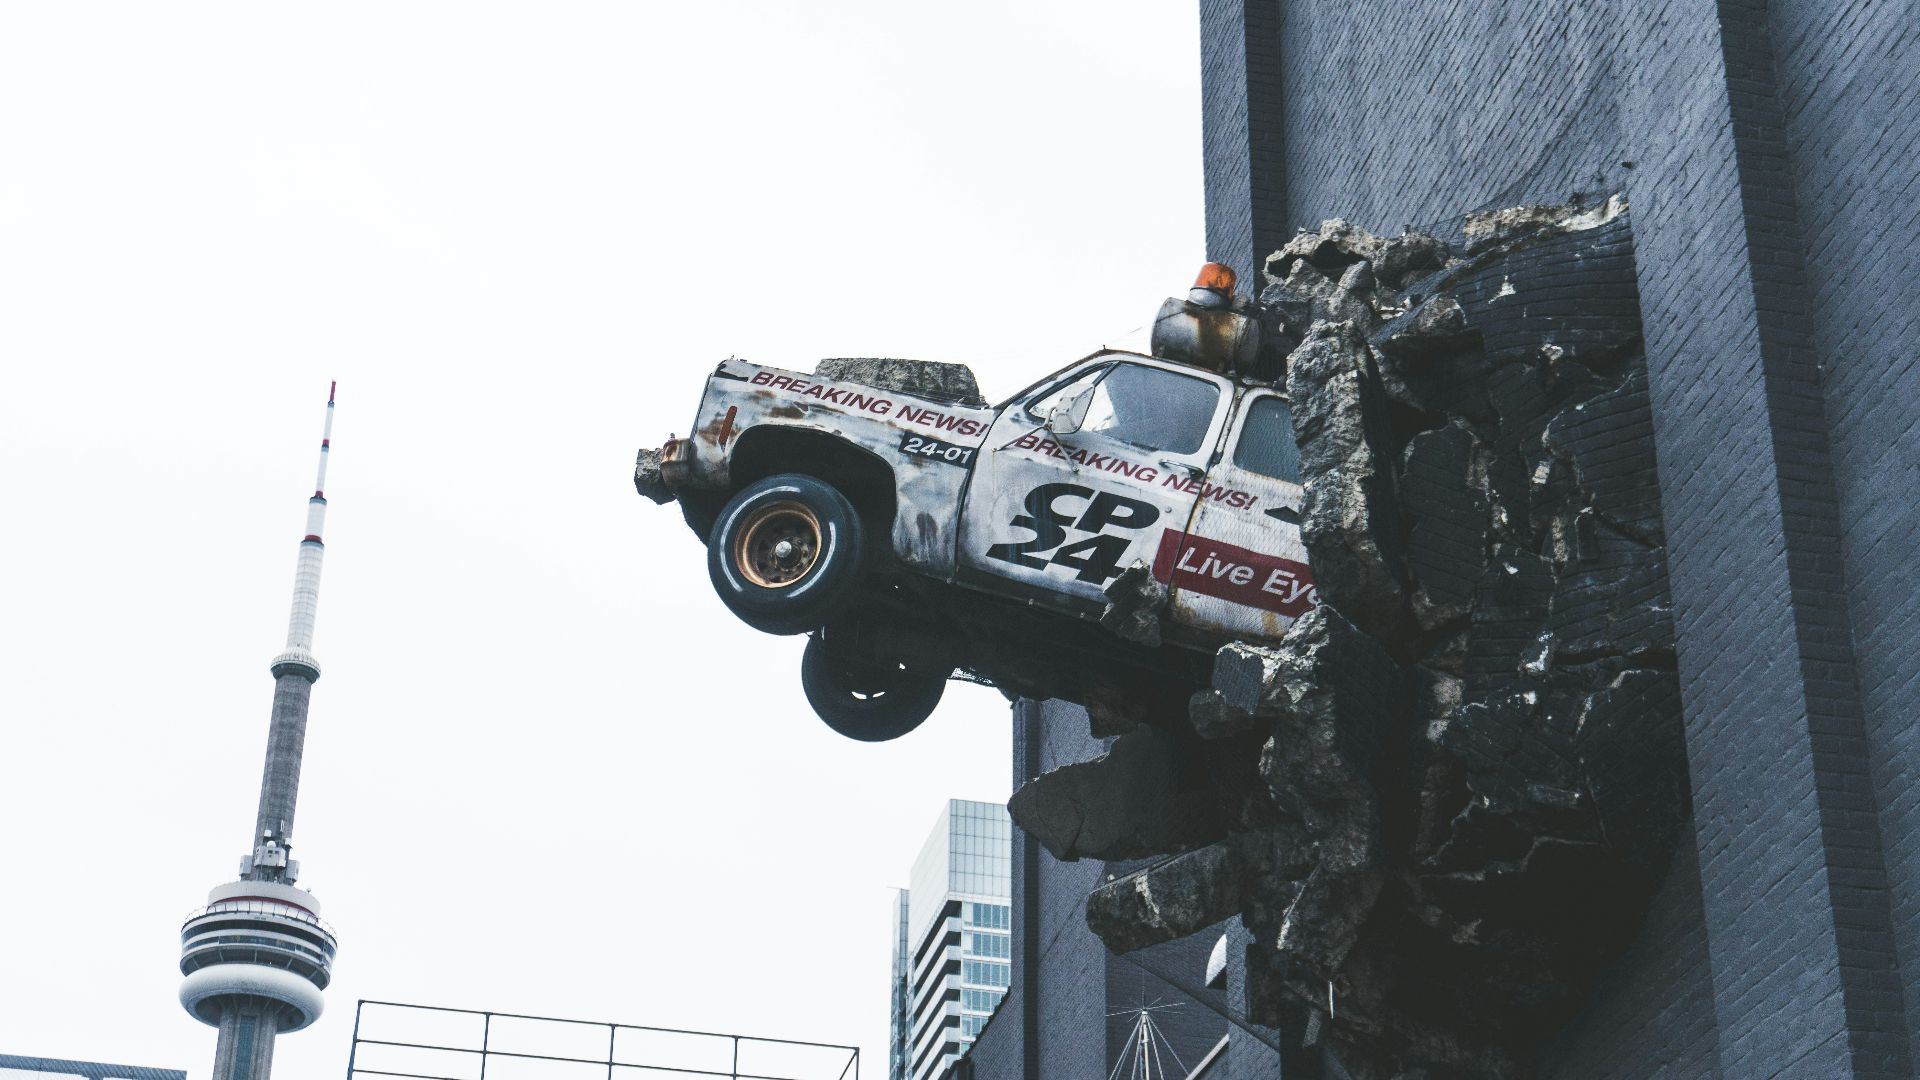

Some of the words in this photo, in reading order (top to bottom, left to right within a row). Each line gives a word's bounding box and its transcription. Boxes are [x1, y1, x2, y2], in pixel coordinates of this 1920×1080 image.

[750, 372, 892, 415] BREAKING
[896, 405, 989, 438] NEWS!
[906, 437, 972, 464] 24-01
[1013, 435, 1159, 483] BREAKING
[1162, 473, 1259, 511] NEWS!
[1024, 483, 1160, 534] CP
[985, 515, 1132, 586] 24
[1177, 547, 1255, 586] Live
